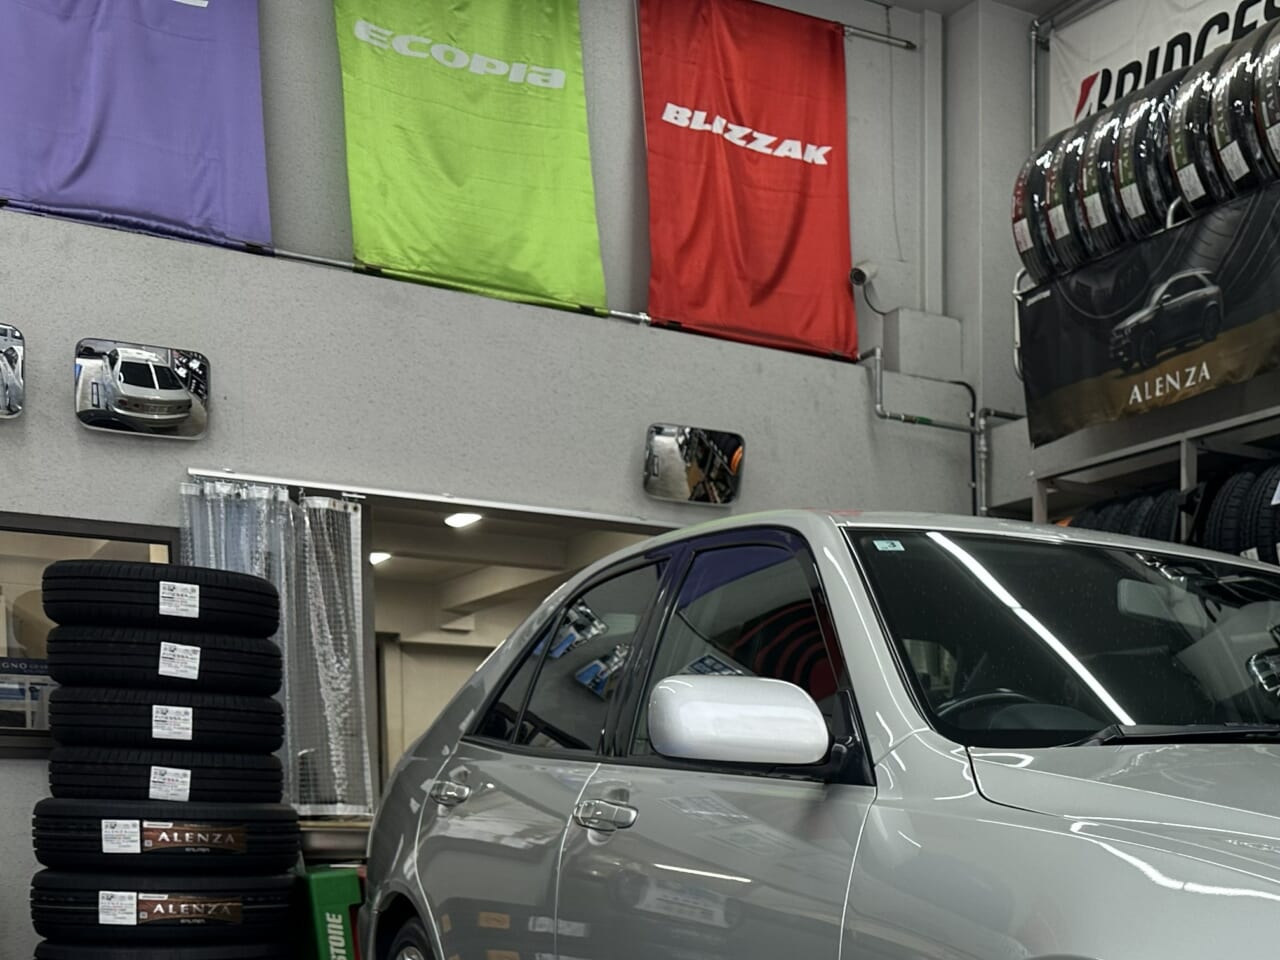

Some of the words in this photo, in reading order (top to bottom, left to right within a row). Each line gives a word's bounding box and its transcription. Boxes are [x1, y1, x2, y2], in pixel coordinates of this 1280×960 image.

[662, 102, 832, 165] BLIZZAK
[1128, 361, 1211, 405] ALENZA
[158, 832, 235, 843] ALENZA
[153, 904, 231, 914] ALENZA
